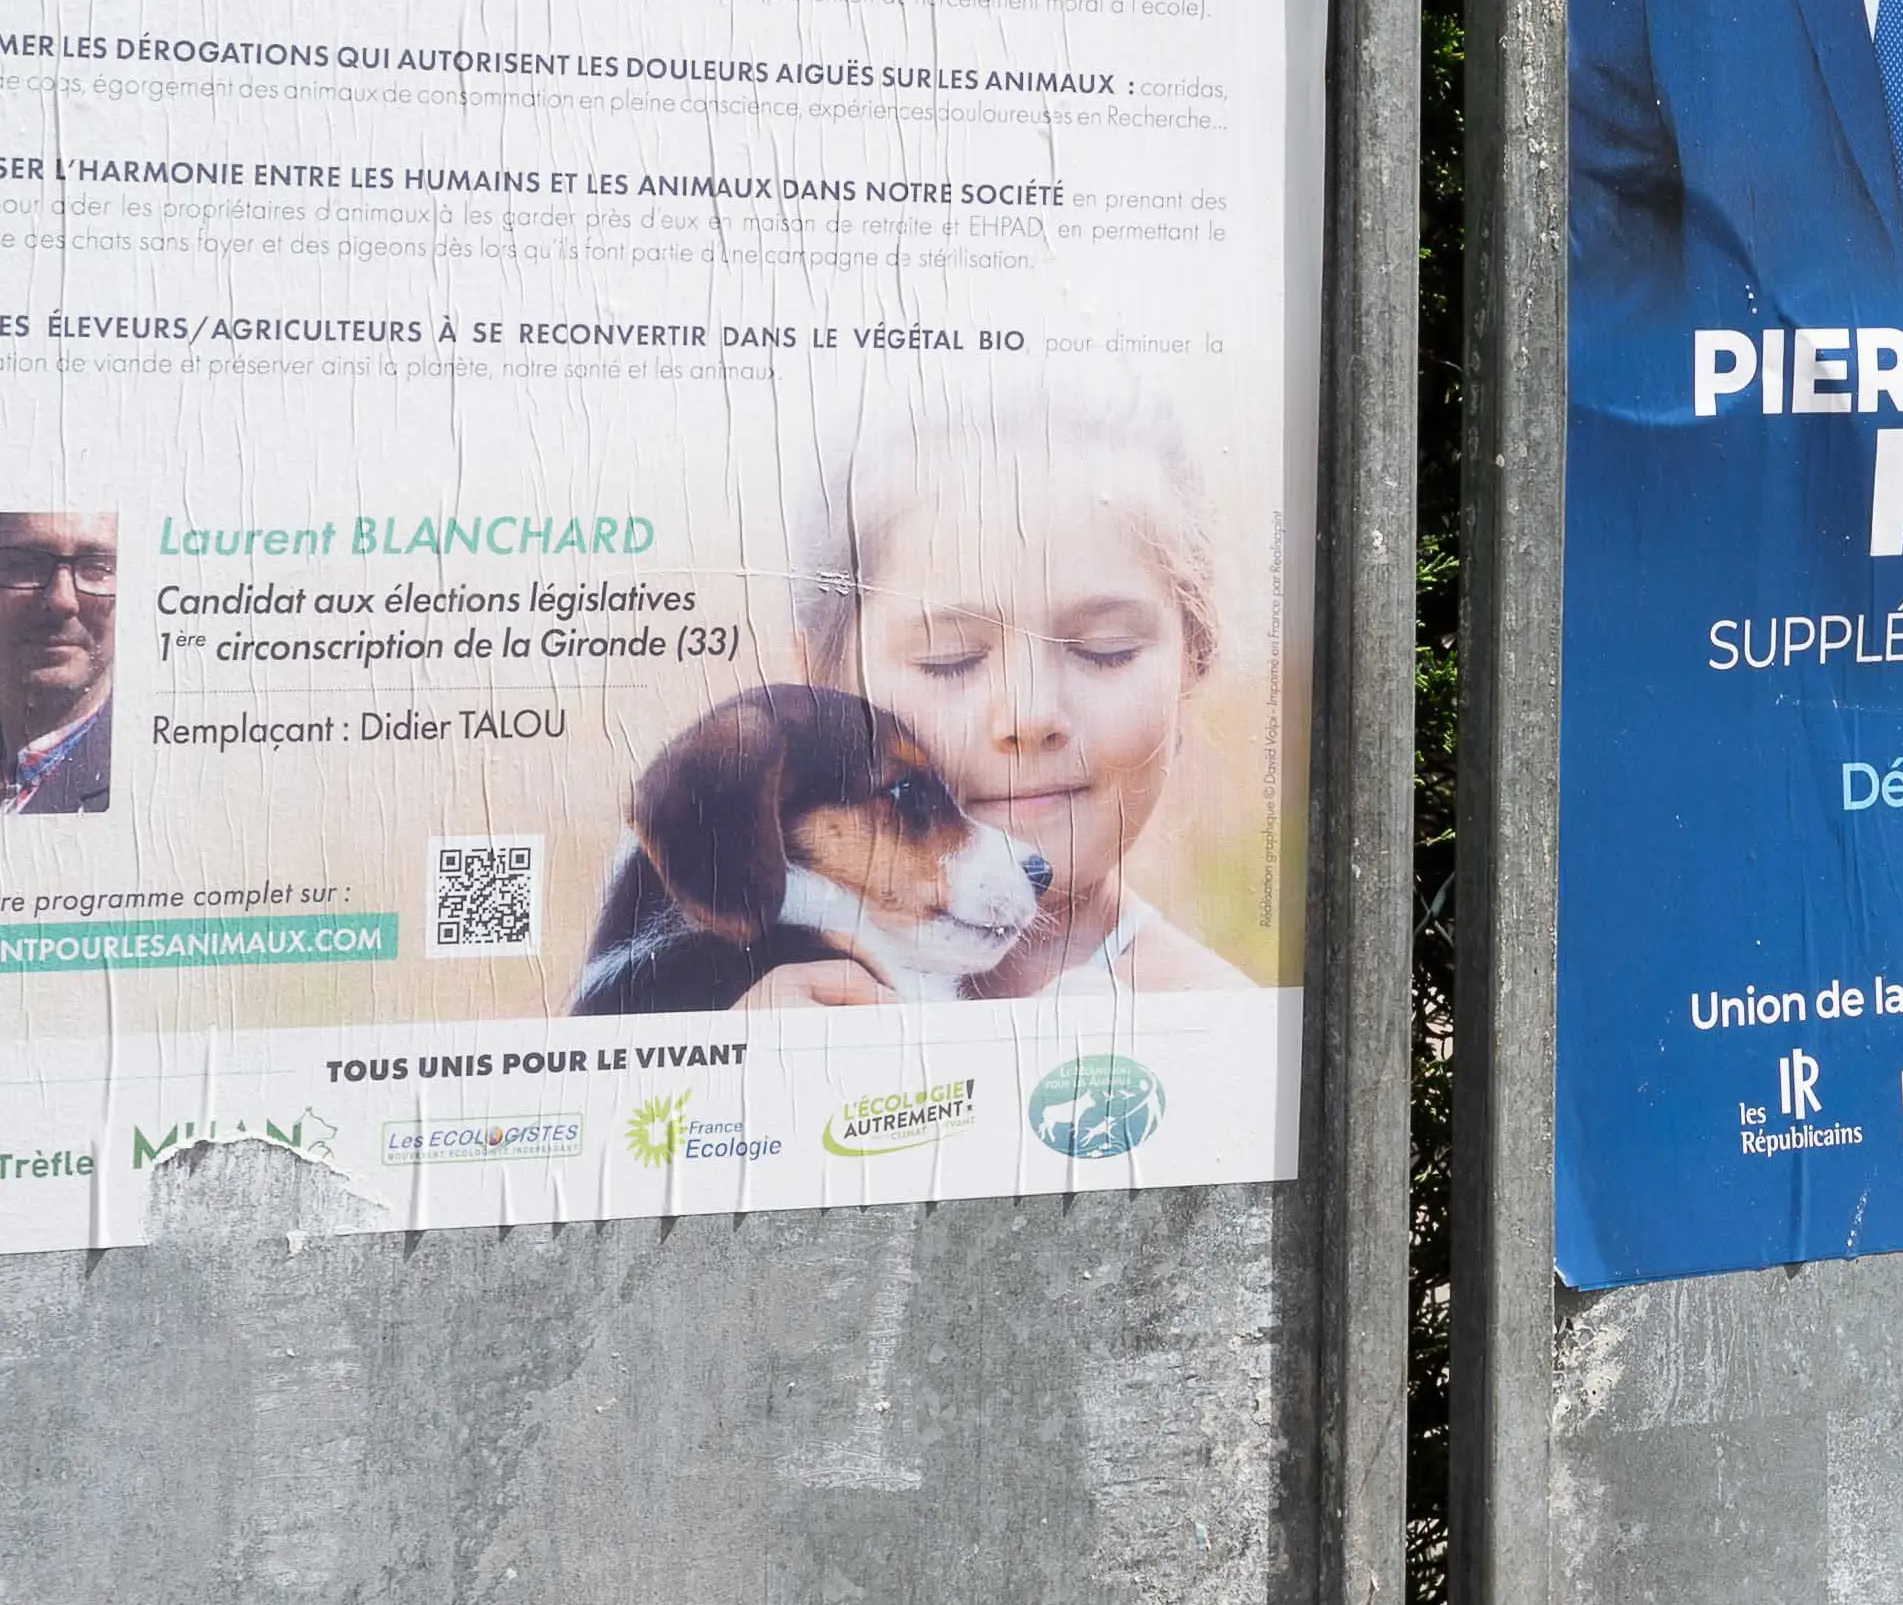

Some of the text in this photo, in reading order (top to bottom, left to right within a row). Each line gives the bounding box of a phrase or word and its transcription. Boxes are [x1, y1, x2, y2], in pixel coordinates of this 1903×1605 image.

[160, 514, 655, 557] Laurent BLANCHARD
[158, 581, 695, 621] Candidat aux élections législatives
[161, 625, 738, 668] 1ère circonscription de la Gironde (33)
[154, 709, 564, 753] Remplaçant Didier TALOU
[1692, 986, 1805, 1029] Union
[1816, 980, 1864, 1018] de
[327, 1044, 747, 1082] TOUS UNIS POUR LE VIVANT
[686, 1119, 781, 1160] France Ecologie
[1741, 1123, 1862, 1157] Républicains
